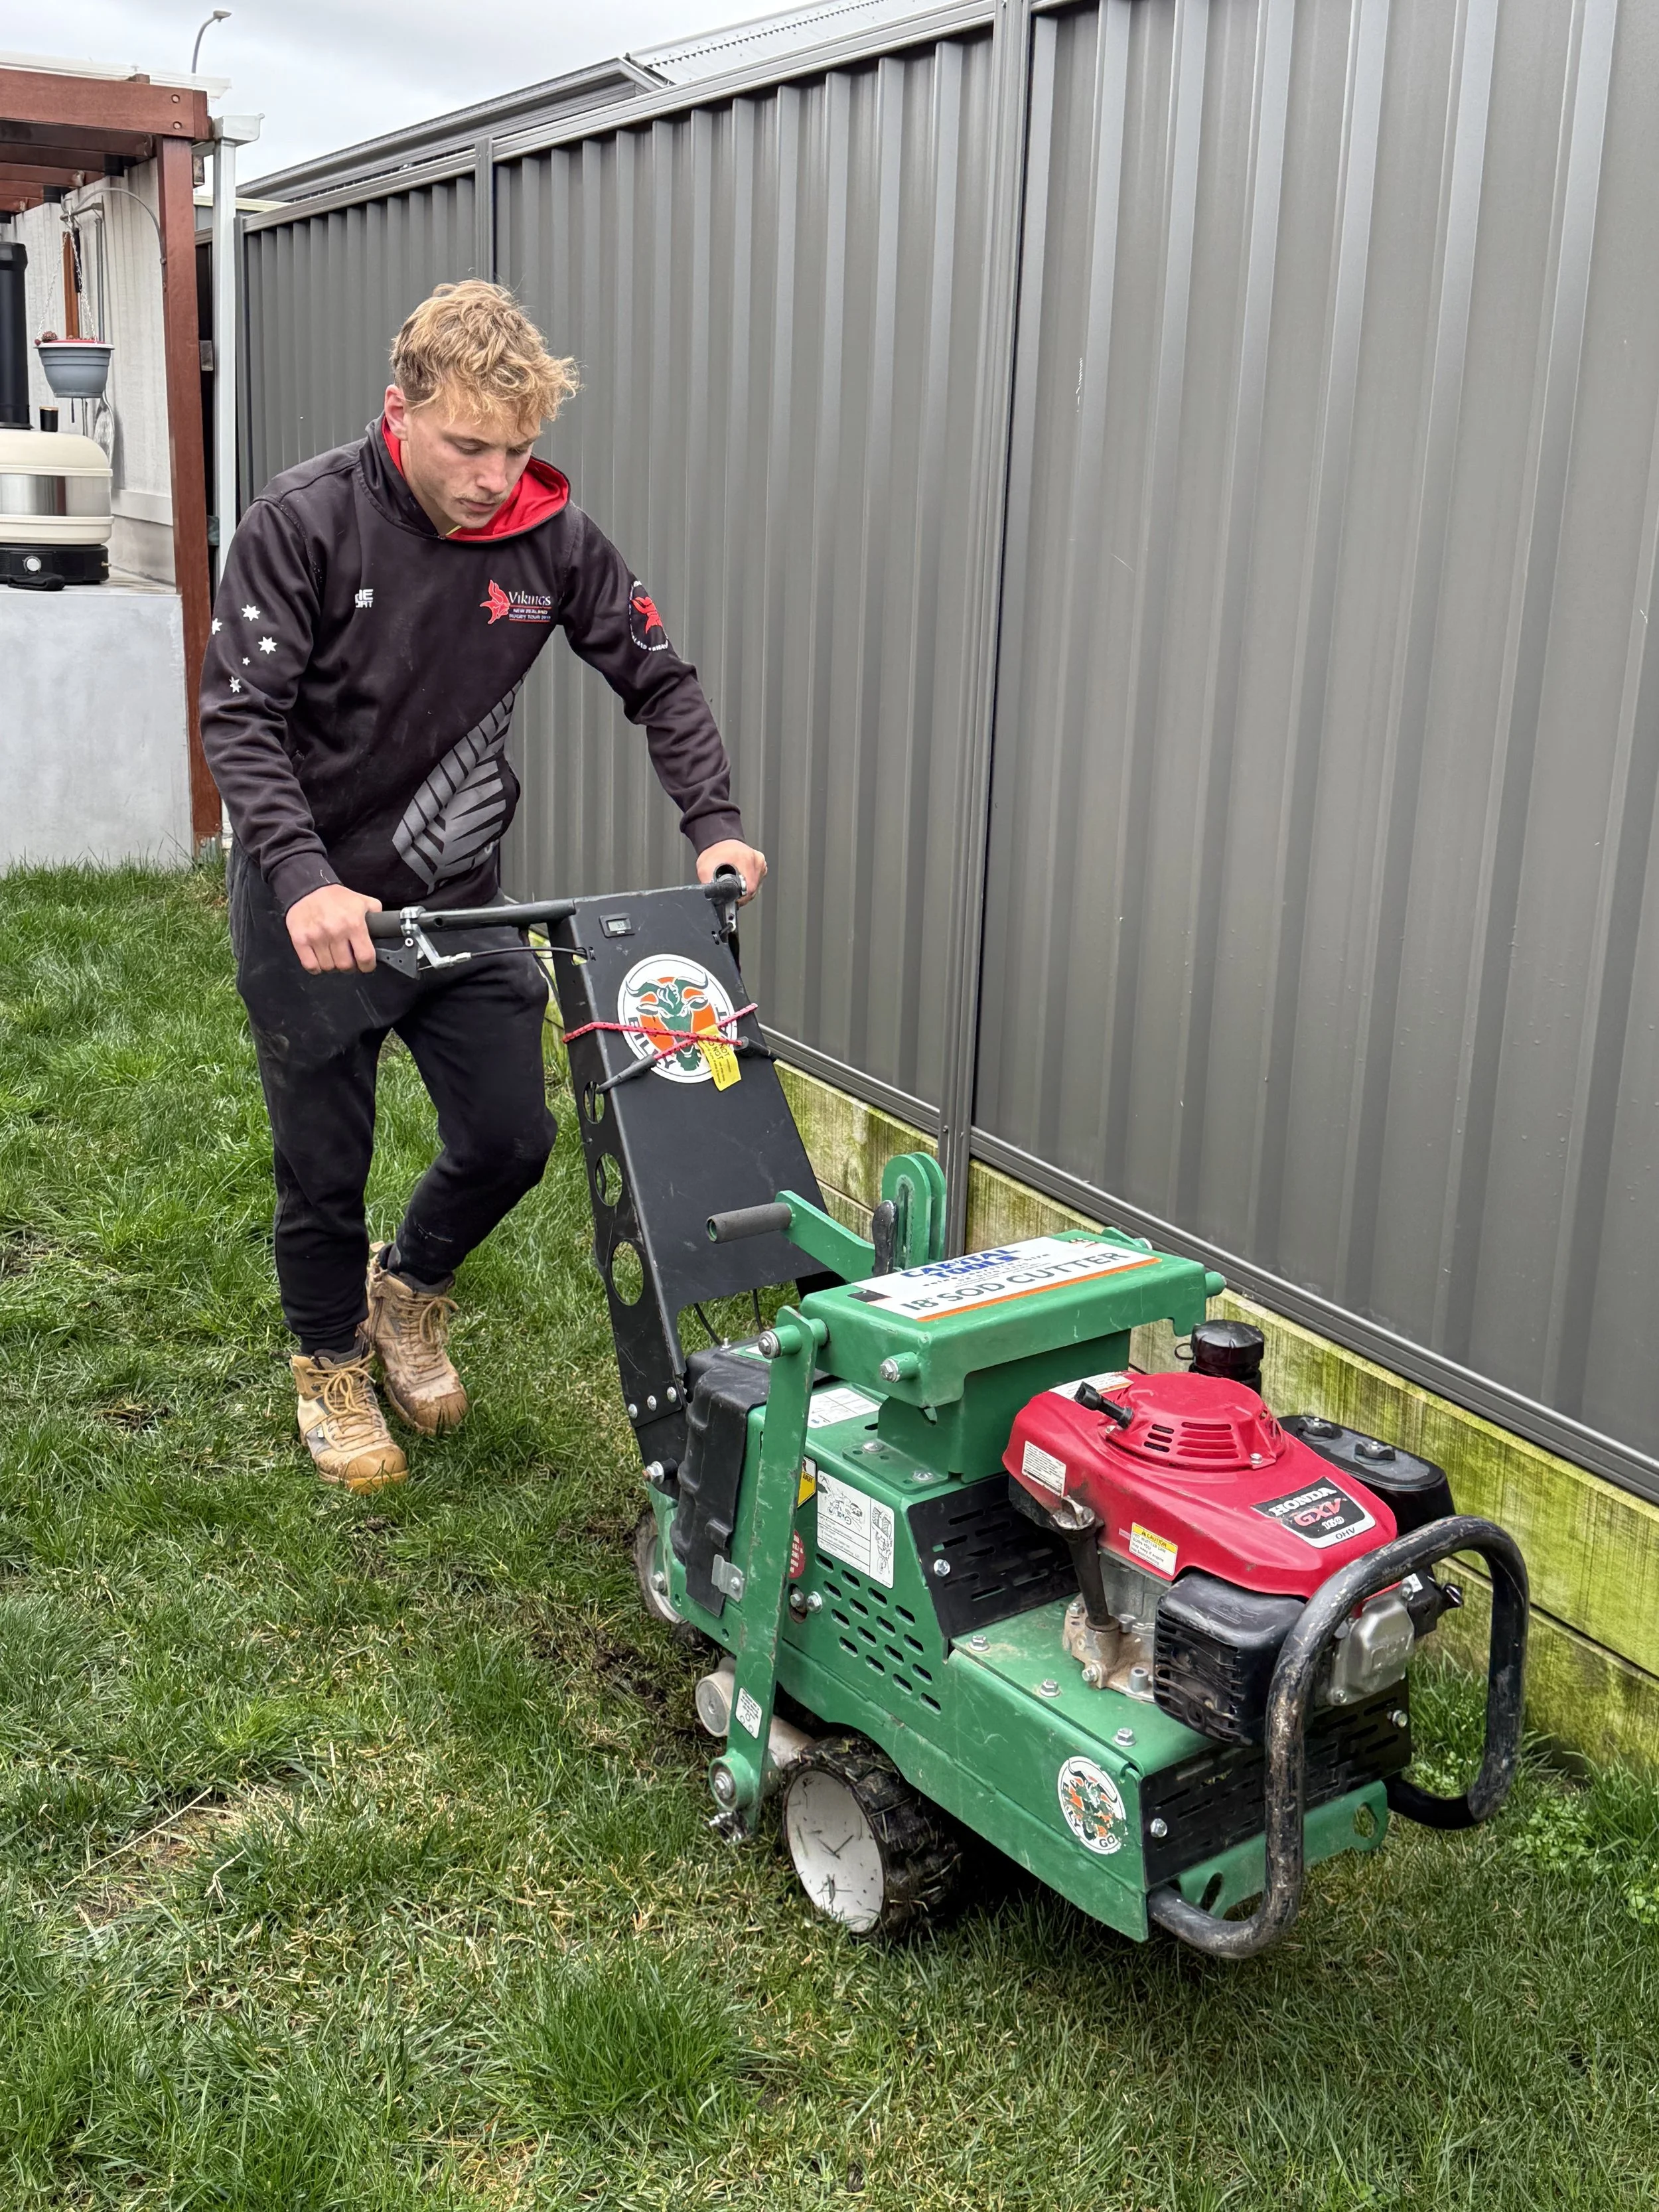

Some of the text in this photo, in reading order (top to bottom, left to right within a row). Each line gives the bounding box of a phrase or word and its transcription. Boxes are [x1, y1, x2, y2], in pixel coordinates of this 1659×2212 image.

[508, 590, 551, 606] Vikings
[712, 1046, 724, 1060] NOT
[719, 1043, 730, 1057] NOT
[928, 1255, 1021, 1278] TOOLS
[936, 1283, 1005, 1301] SOD
[1006, 1252, 1131, 1284] CUTTER
[1268, 1487, 1337, 1517] HONDA
[1295, 1497, 1342, 1526] GXV
[1147, 1532, 1167, 1548] CAUTION
[1335, 1527, 1355, 1540] OHV
